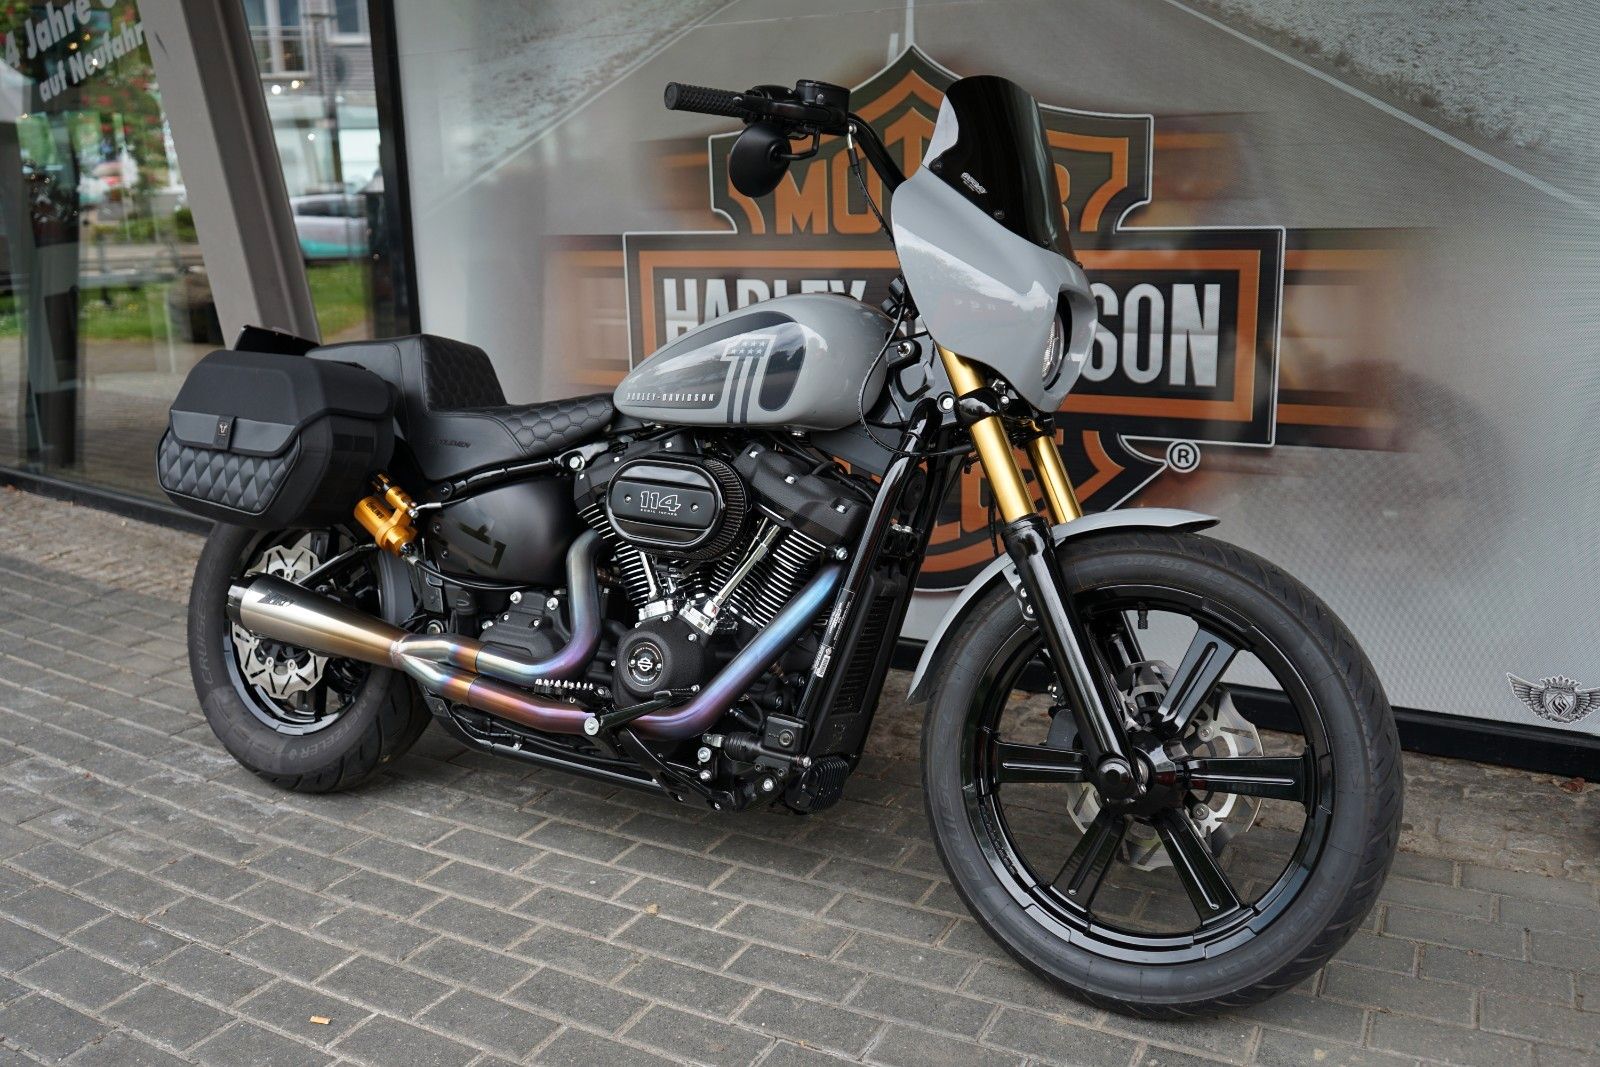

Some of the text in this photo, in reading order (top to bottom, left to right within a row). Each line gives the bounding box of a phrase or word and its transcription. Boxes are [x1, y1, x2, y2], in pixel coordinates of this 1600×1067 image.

[25, 0, 91, 59] Jahre
[39, 60, 68, 102] auf
[640, 491, 681, 512] 114
